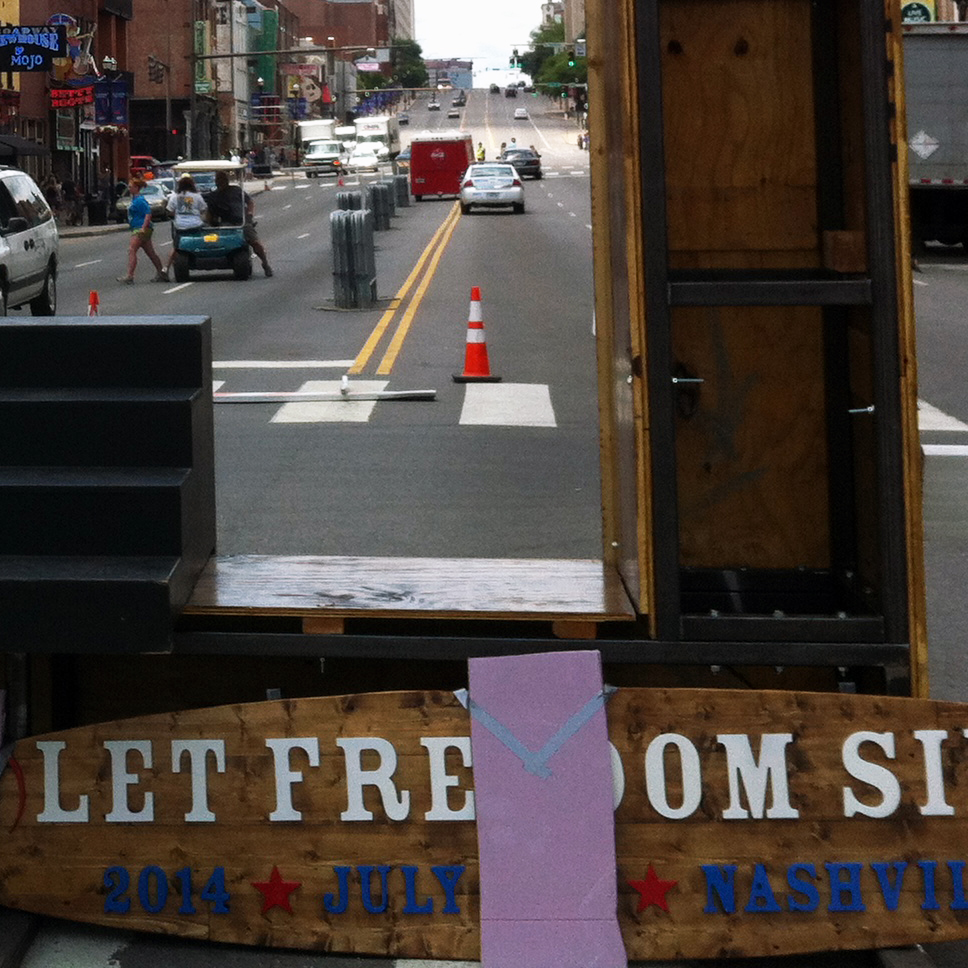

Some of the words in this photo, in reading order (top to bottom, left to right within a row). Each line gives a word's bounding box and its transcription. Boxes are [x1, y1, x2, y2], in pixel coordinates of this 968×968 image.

[11, 55, 43, 70] MOJO
[36, 739, 226, 823] LET
[265, 733, 800, 822] FREOM
[103, 865, 231, 915] 2014
[323, 865, 466, 915] JULY
